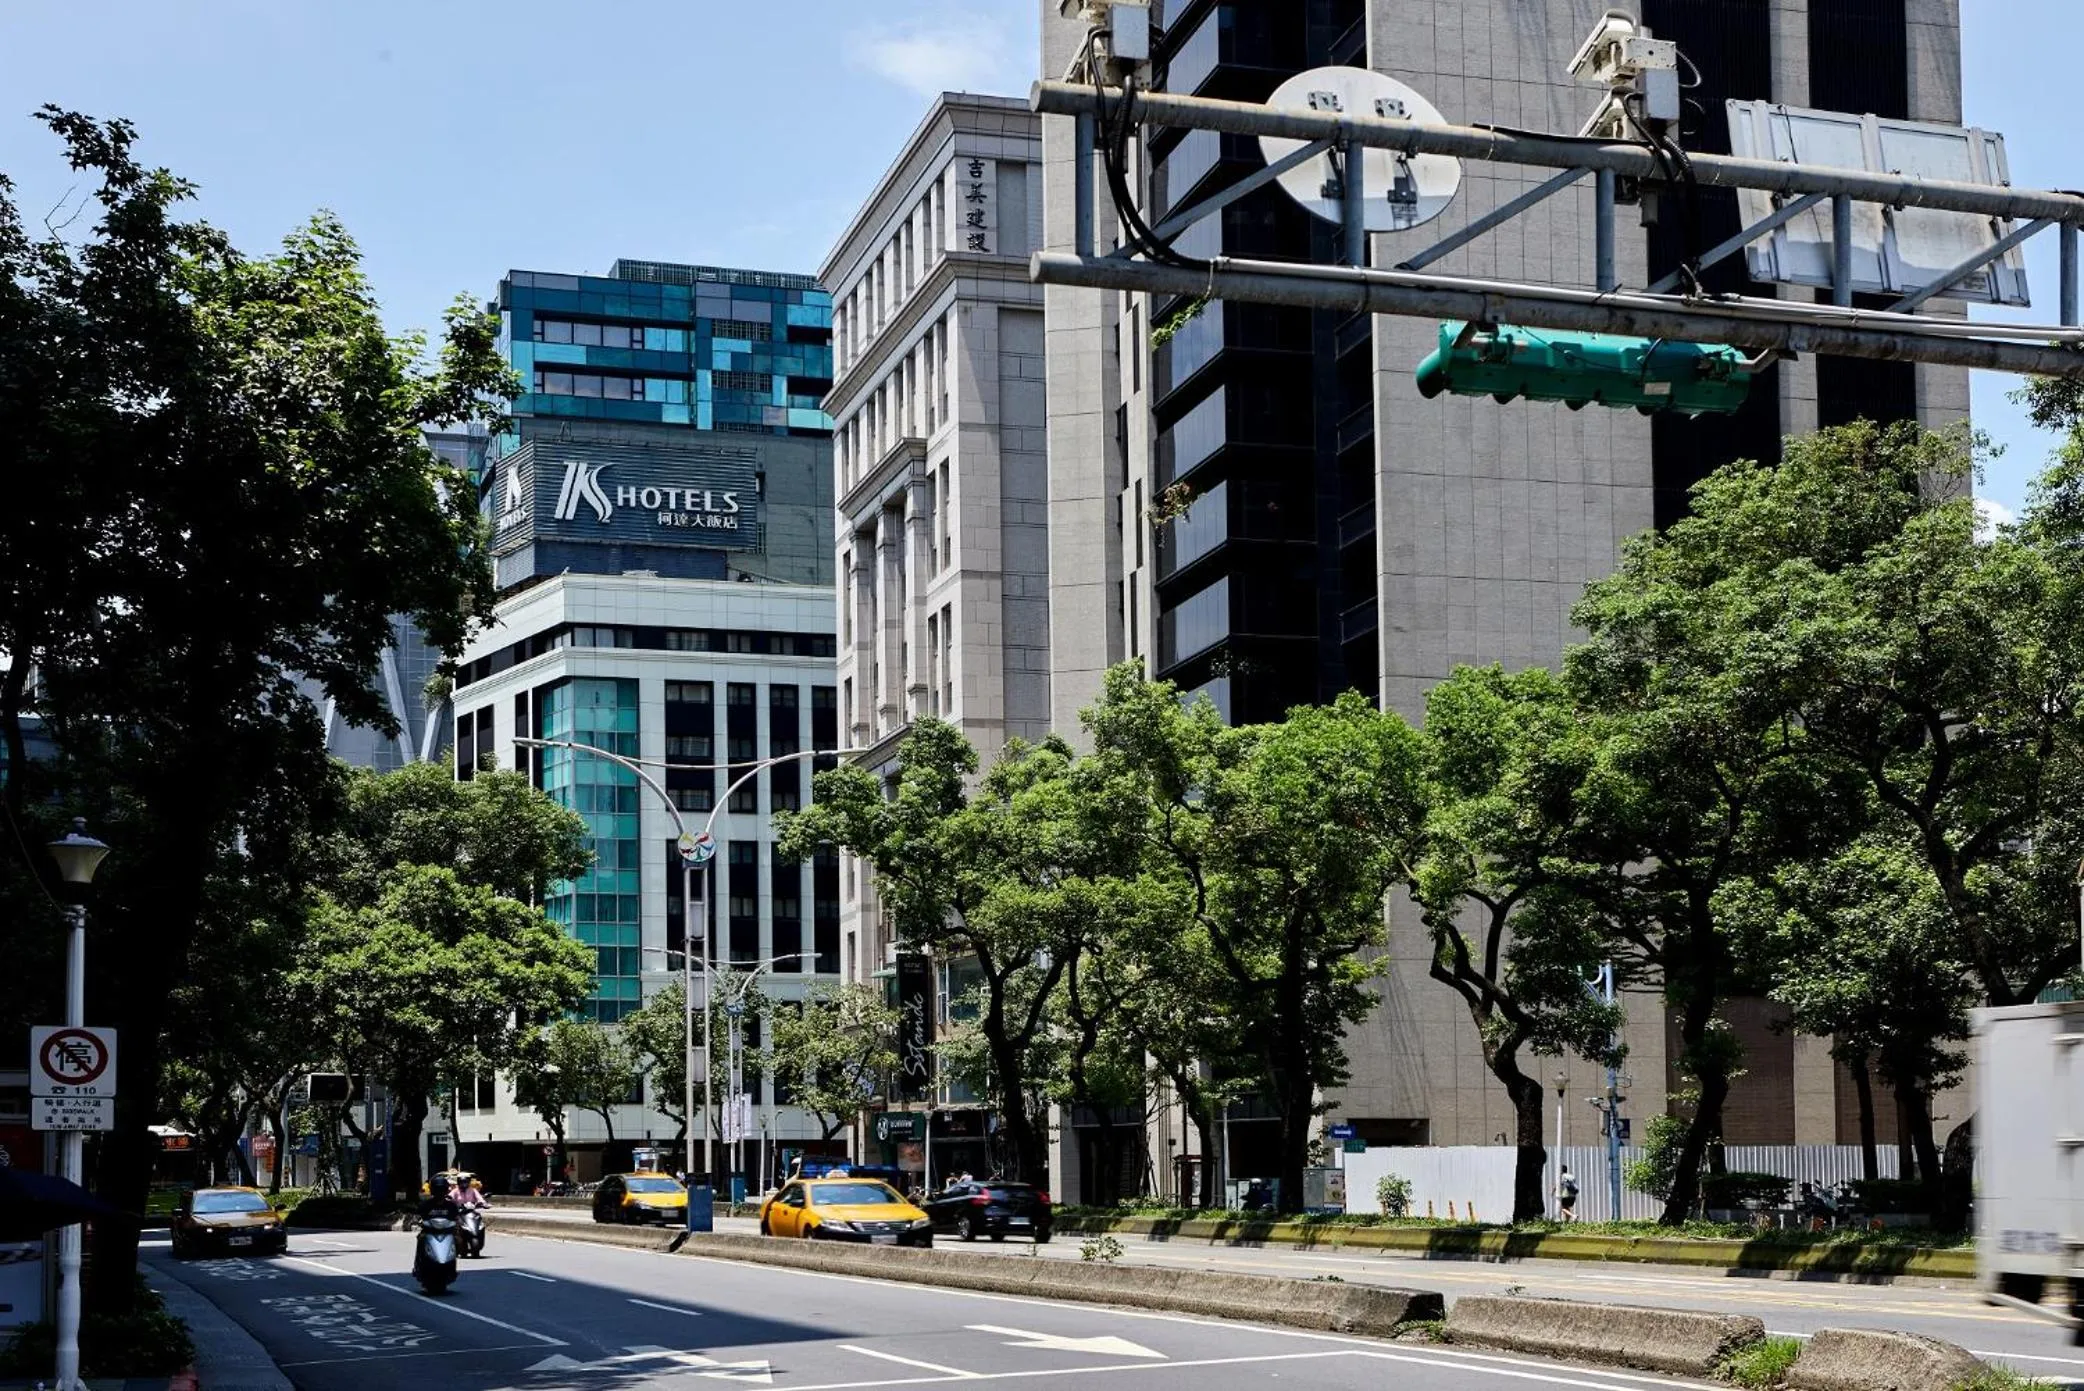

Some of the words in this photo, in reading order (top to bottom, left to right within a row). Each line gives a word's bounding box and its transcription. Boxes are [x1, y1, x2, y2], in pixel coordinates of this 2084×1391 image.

[617, 485, 740, 514] HOTELS
[657, 511, 738, 530] 柯達大飯店
[75, 1086, 97, 1095] 110
